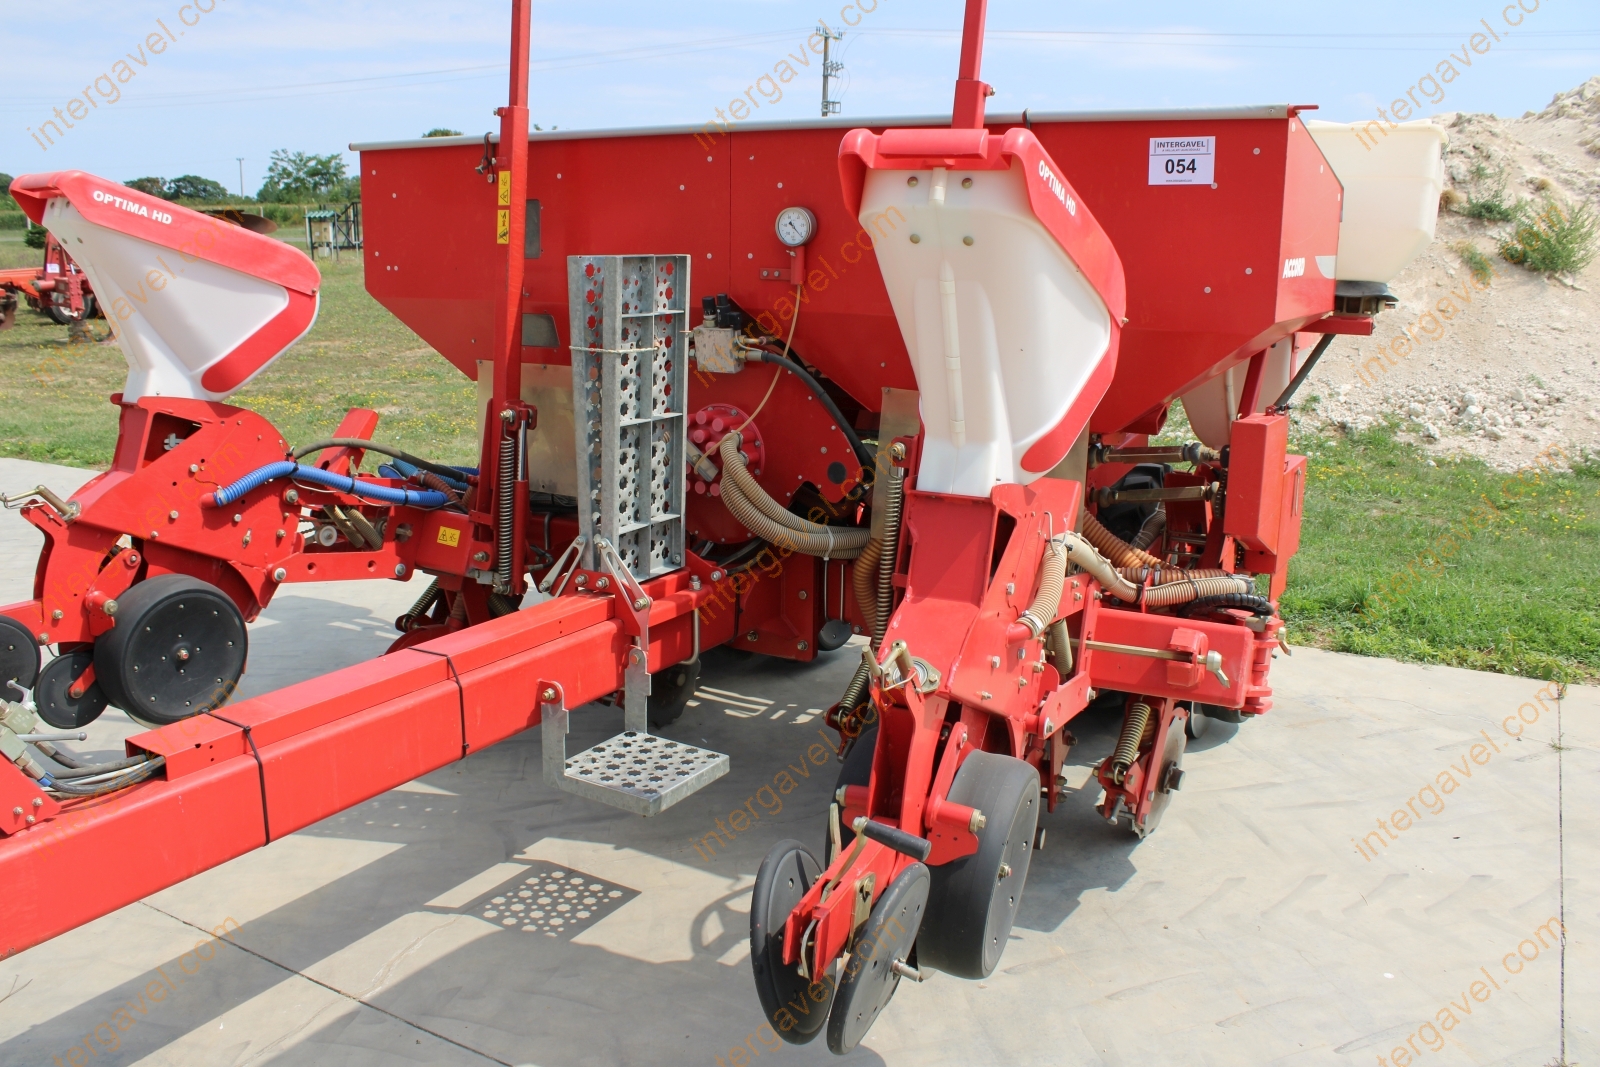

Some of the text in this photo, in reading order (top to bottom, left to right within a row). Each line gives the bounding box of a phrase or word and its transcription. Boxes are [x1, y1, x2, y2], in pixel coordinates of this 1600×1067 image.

[1157, 141, 1206, 149] INTERGAVEL
[1165, 158, 1197, 174] 054
[1038, 159, 1076, 217] OPTIMA HD
[93, 190, 173, 225] OPTIMA HD
